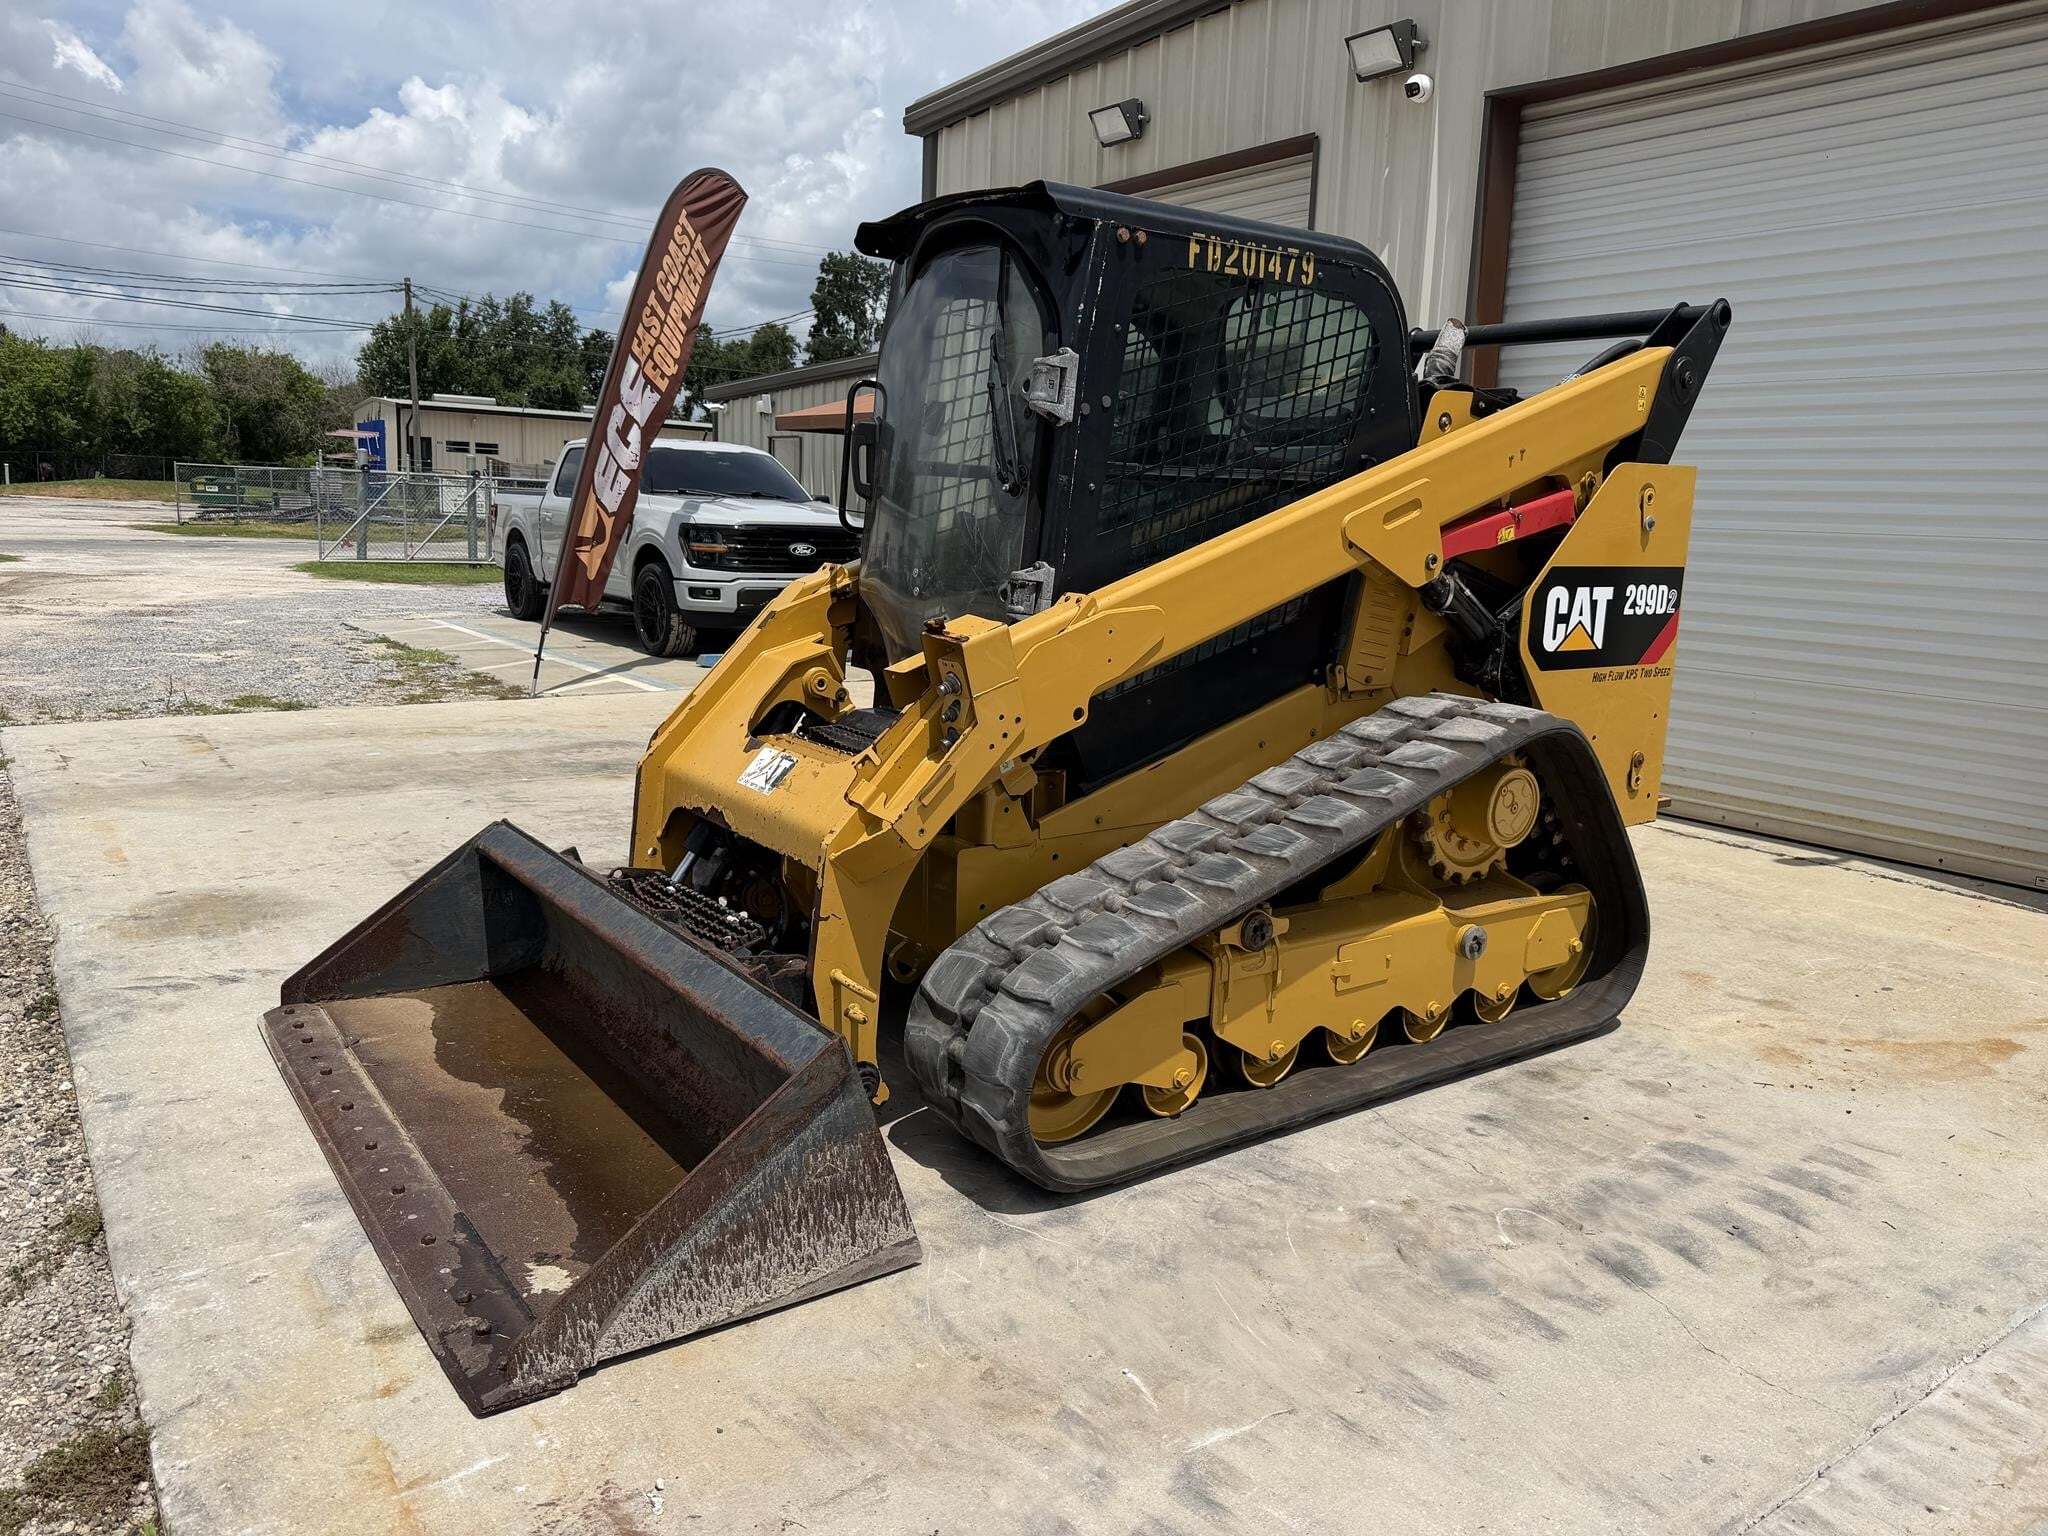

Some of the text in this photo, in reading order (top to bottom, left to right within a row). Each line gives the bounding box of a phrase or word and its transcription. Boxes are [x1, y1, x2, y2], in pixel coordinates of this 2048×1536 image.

[631, 208, 696, 365] EAST COAST
[1188, 232, 1316, 286] FD201479
[643, 233, 711, 393] EQUIPMENT
[1542, 584, 1678, 652] CAT 299D2
[1624, 668, 1639, 680] XPS
